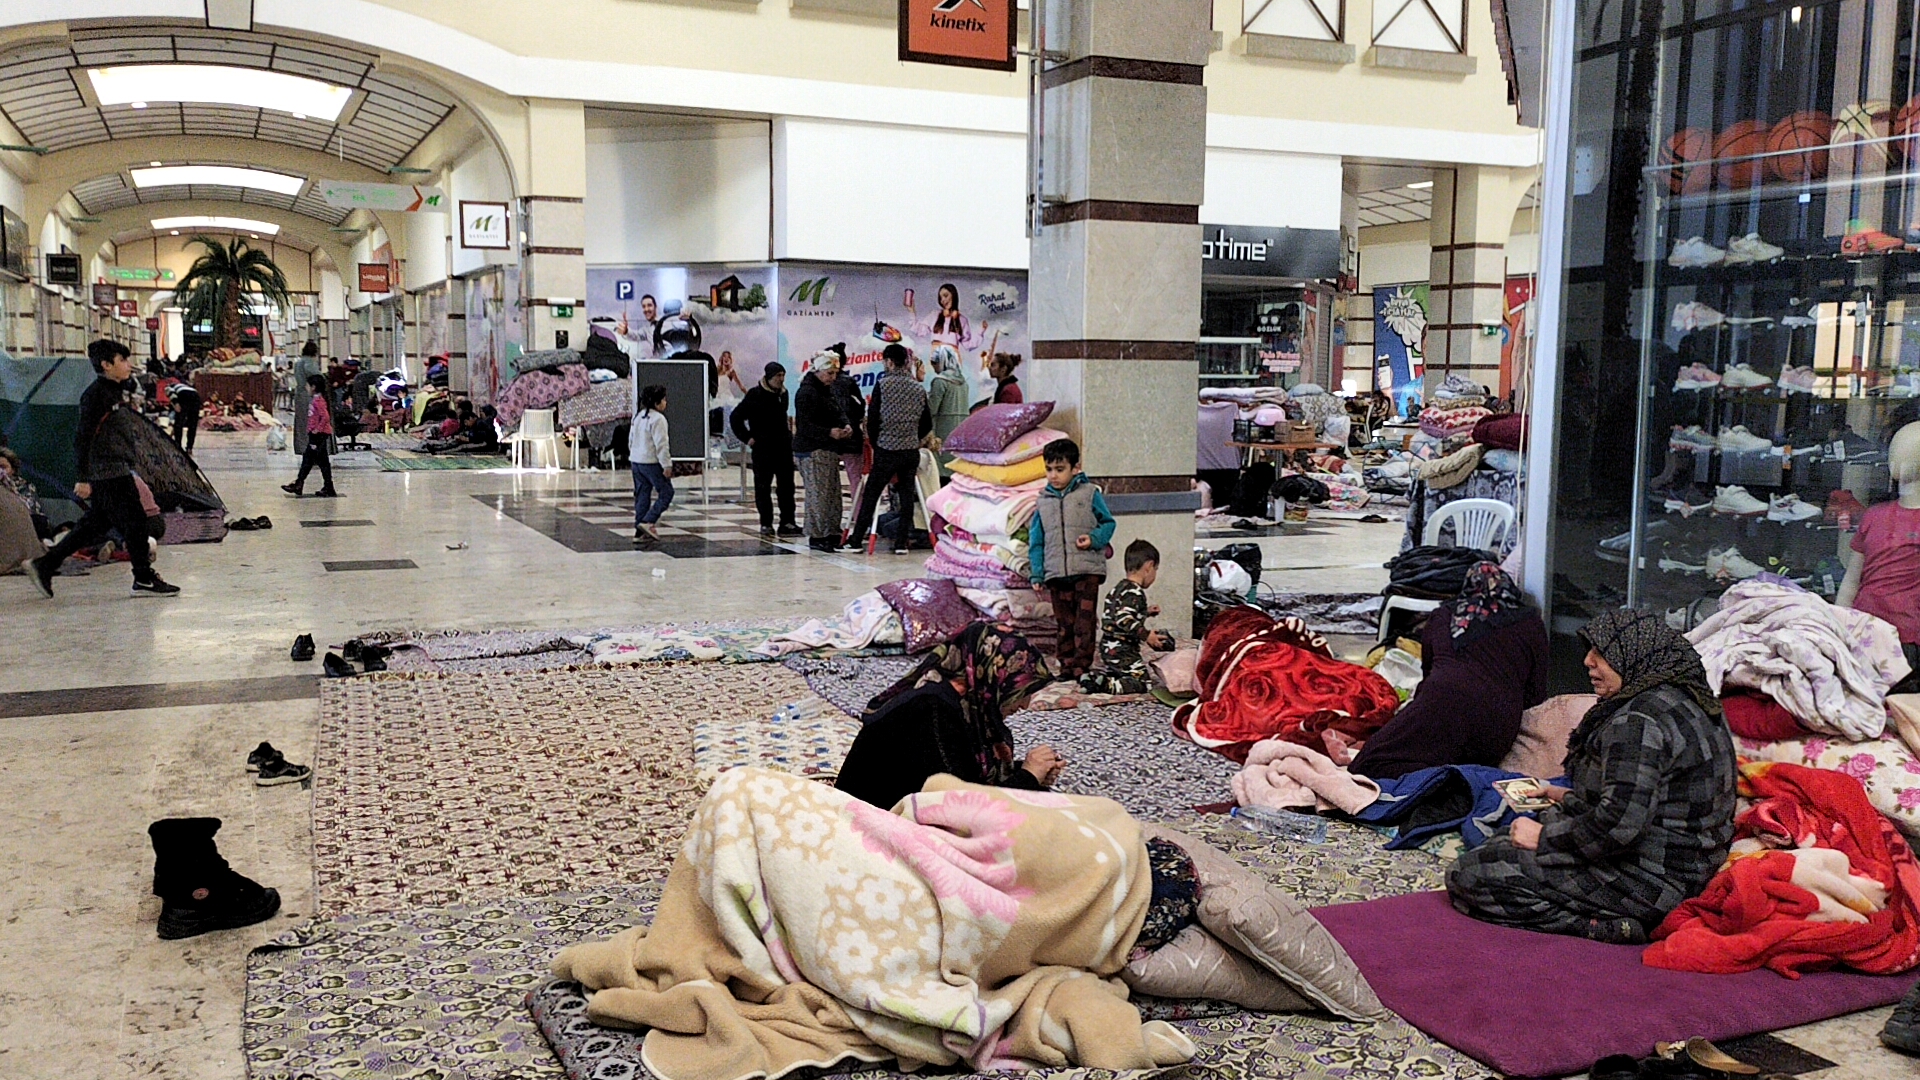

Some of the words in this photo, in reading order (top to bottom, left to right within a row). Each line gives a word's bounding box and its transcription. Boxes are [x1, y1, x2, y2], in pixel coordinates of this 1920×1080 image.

[930, 13, 986, 32] kinetix
[619, 283, 632, 299] P
[978, 292, 1006, 306] Rahat
[988, 301, 1016, 315] Rahat
